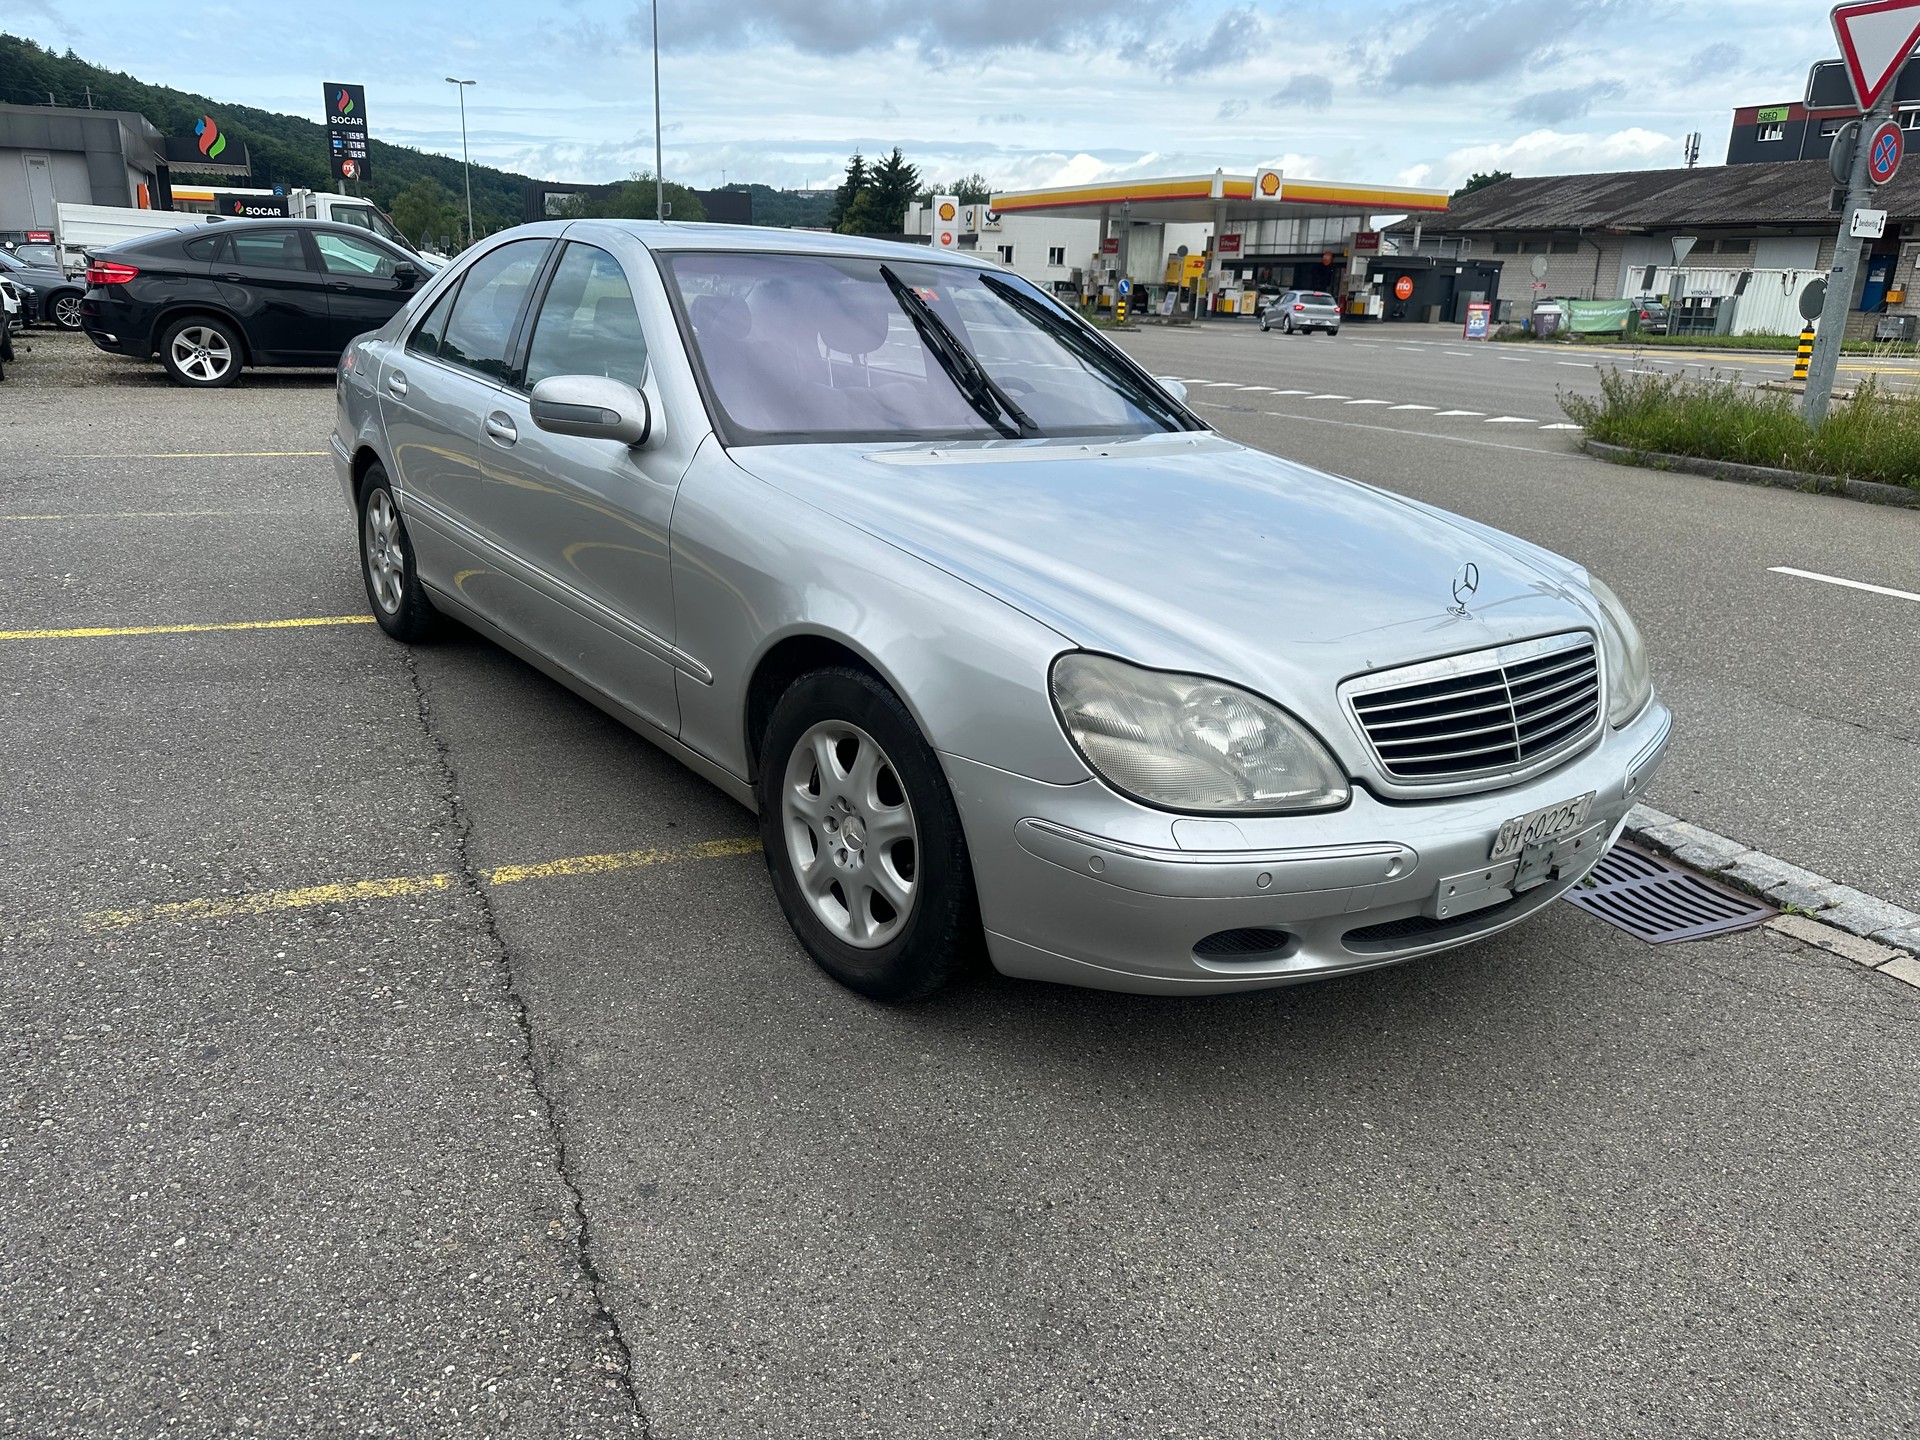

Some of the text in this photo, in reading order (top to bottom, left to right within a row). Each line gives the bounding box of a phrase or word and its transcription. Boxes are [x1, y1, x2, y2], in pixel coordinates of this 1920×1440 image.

[331, 115, 363, 126] SOCAR
[245, 206, 281, 216] SOCAR
[1859, 220, 1879, 229] beidseitig
[1469, 319, 1485, 328] 125
[1495, 820, 1523, 855] SH
[1524, 803, 1579, 843] 60225
